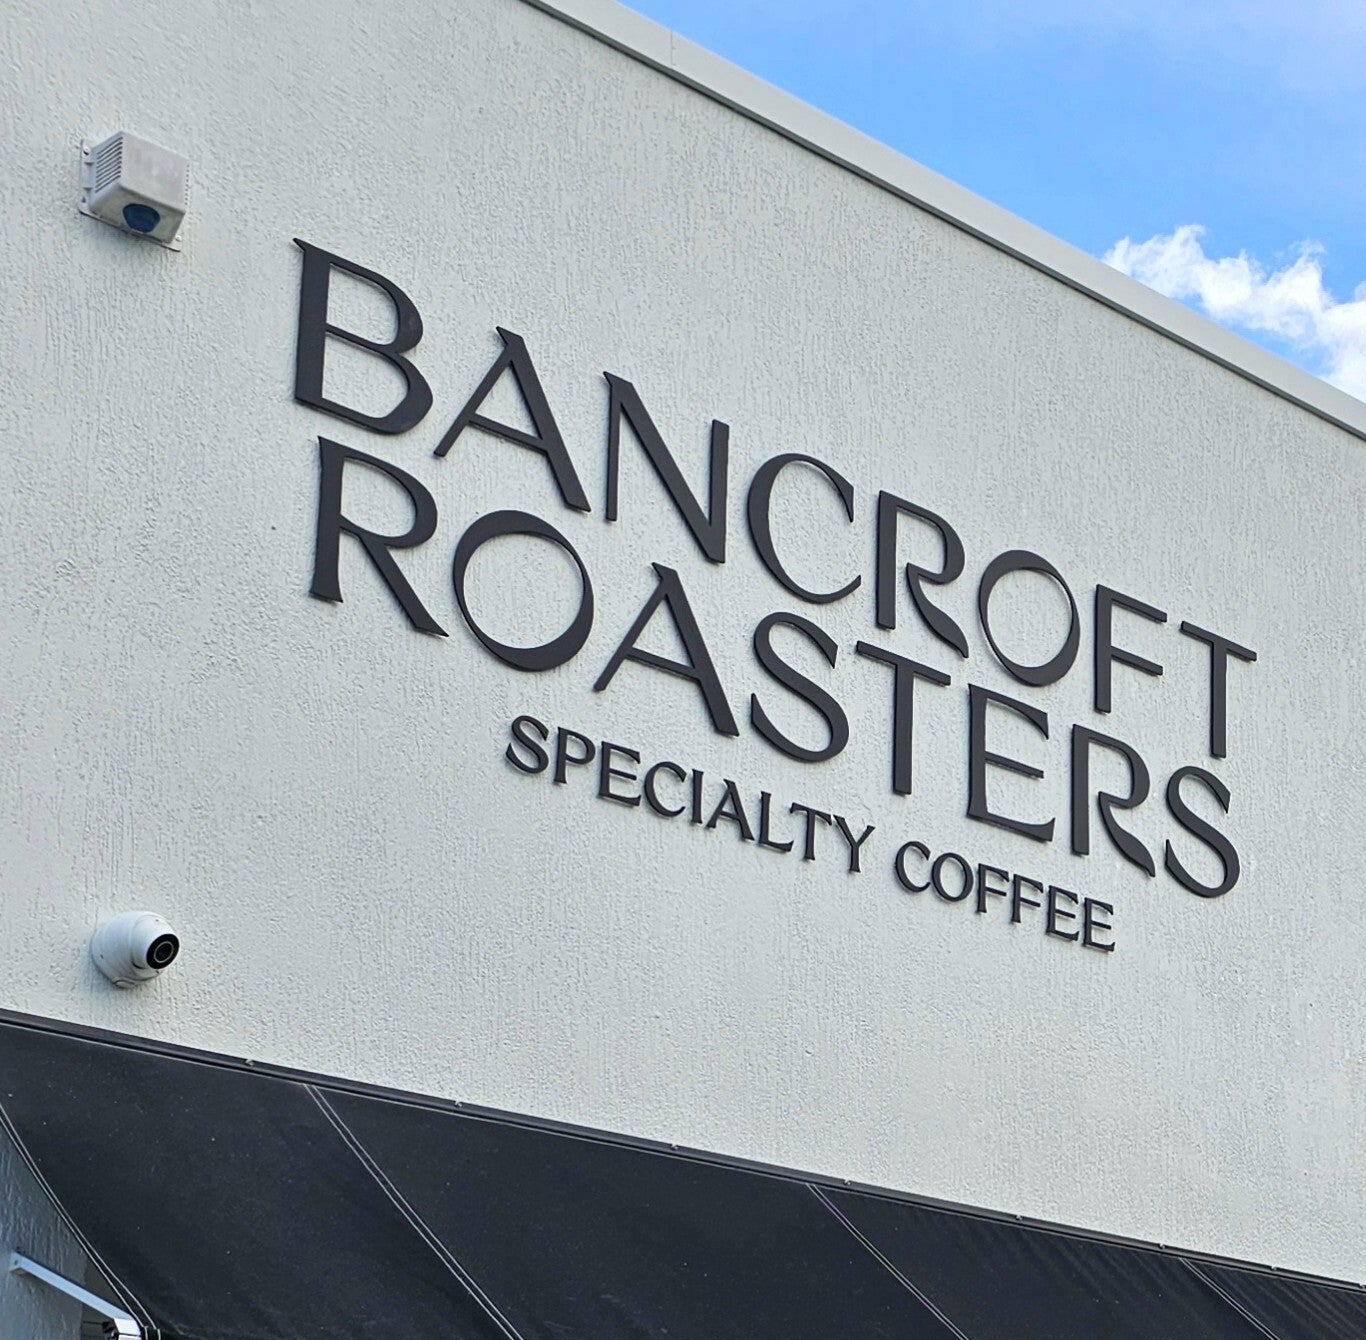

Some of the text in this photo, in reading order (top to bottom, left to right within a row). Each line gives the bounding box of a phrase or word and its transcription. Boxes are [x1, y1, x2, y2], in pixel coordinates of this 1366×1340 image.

[293, 237, 1258, 760] BANCROFT
[308, 434, 1242, 898] ROASTERS
[506, 714, 1116, 952] SPECIALTY COFFEE
